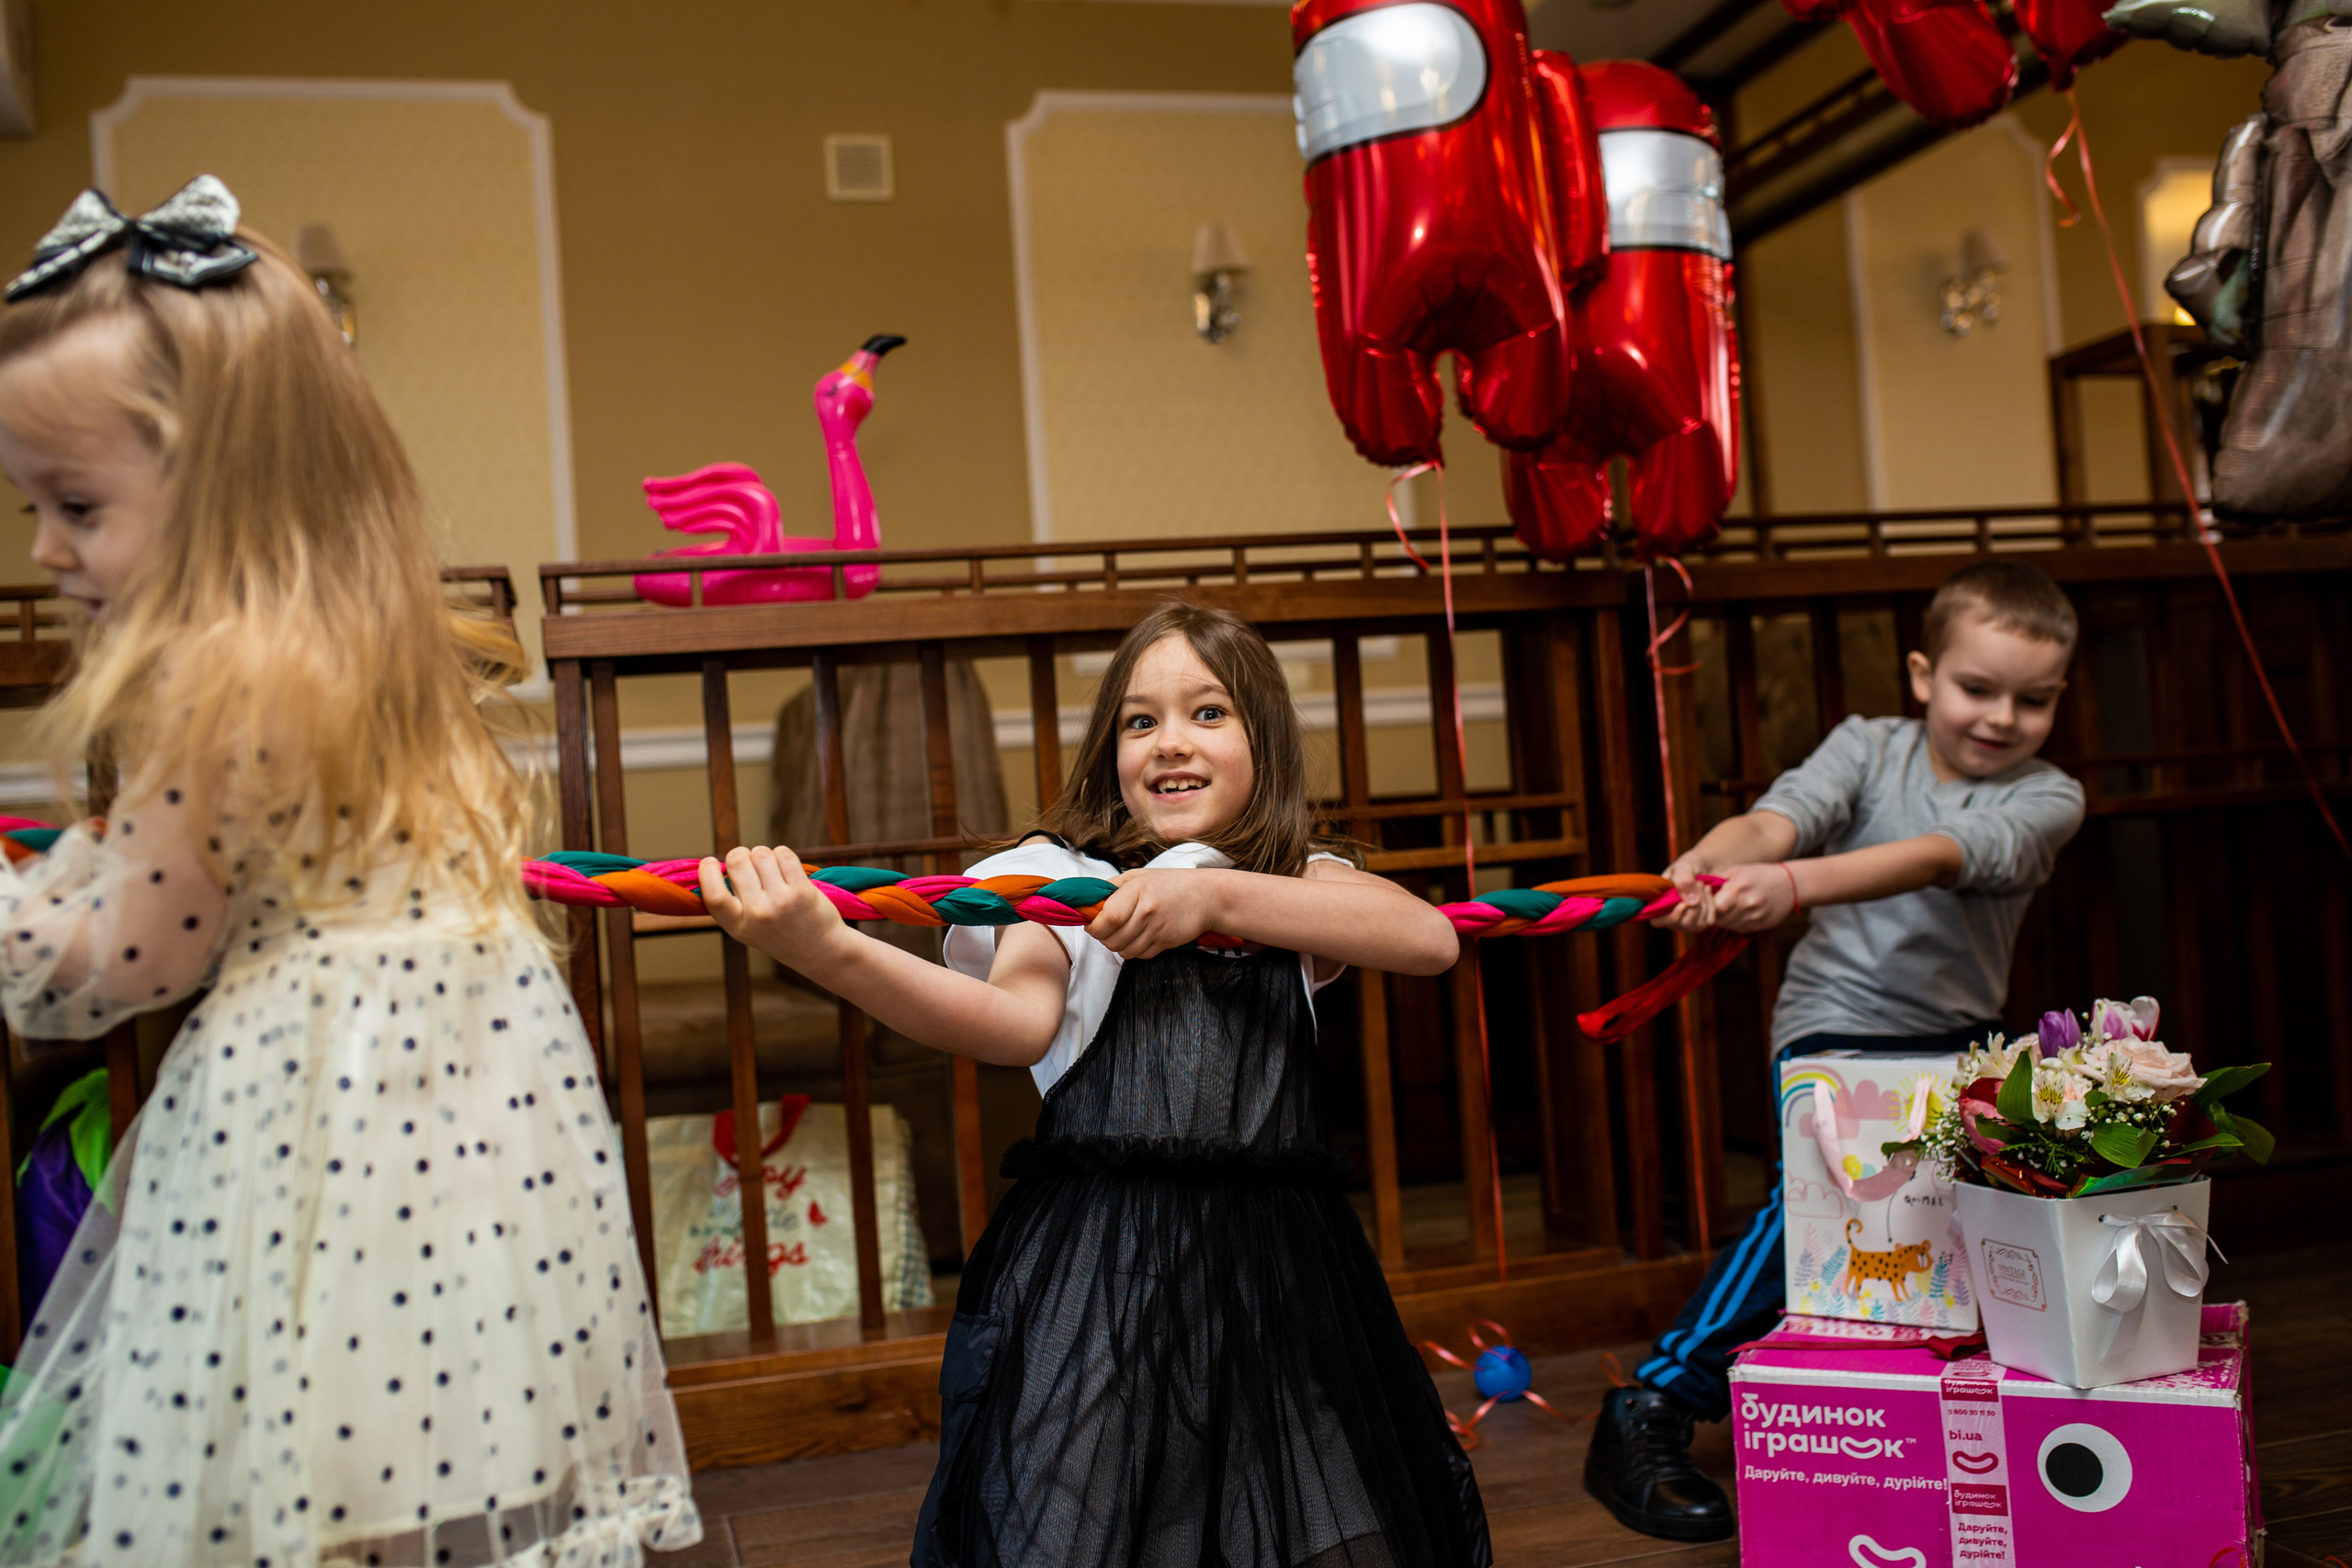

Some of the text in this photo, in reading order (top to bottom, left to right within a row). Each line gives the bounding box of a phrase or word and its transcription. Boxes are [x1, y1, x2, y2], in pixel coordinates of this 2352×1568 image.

[1741, 1393, 1886, 1427] будинок
[1949, 1430, 1983, 1441] bi.ua
[1745, 1465, 1948, 1491] Даруйте, дивуйте, дурійте!
[1953, 1489, 1996, 1499] будинок
[1958, 1522, 2007, 1535] Даруйте,
[1959, 1537, 2007, 1547] дивуйте,
[1960, 1550, 2005, 1560] дурійте!
